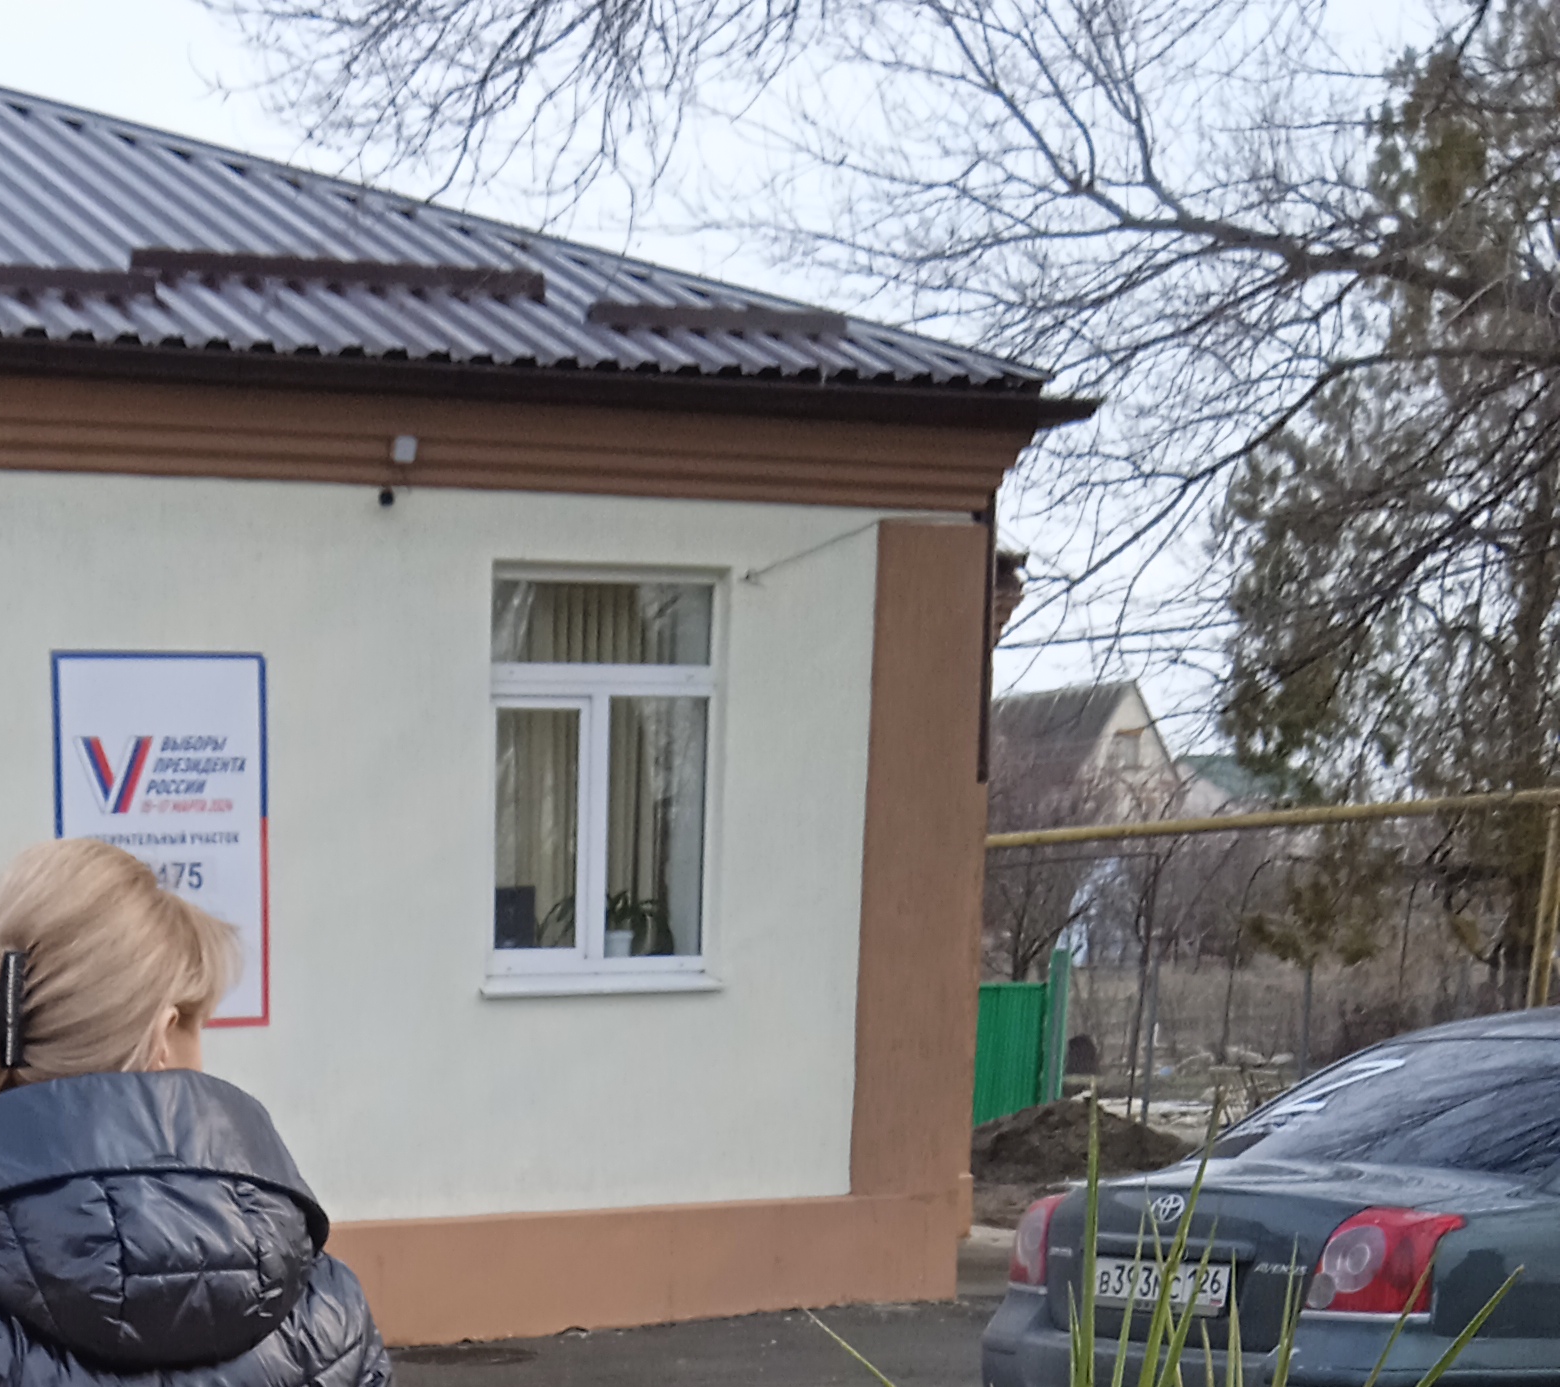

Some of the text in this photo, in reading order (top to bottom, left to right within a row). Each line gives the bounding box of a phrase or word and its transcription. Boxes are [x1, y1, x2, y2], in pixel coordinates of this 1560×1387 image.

[161, 736, 227, 752] ВЫБОРЫ
[153, 757, 247, 774] ПРЕЗИДЕНТА
[146, 780, 207, 795] РОССИИ
[86, 831, 239, 845] БИРАТЕЛЬНЫЙ УЧАСТОК
[147, 862, 203, 889] 475
